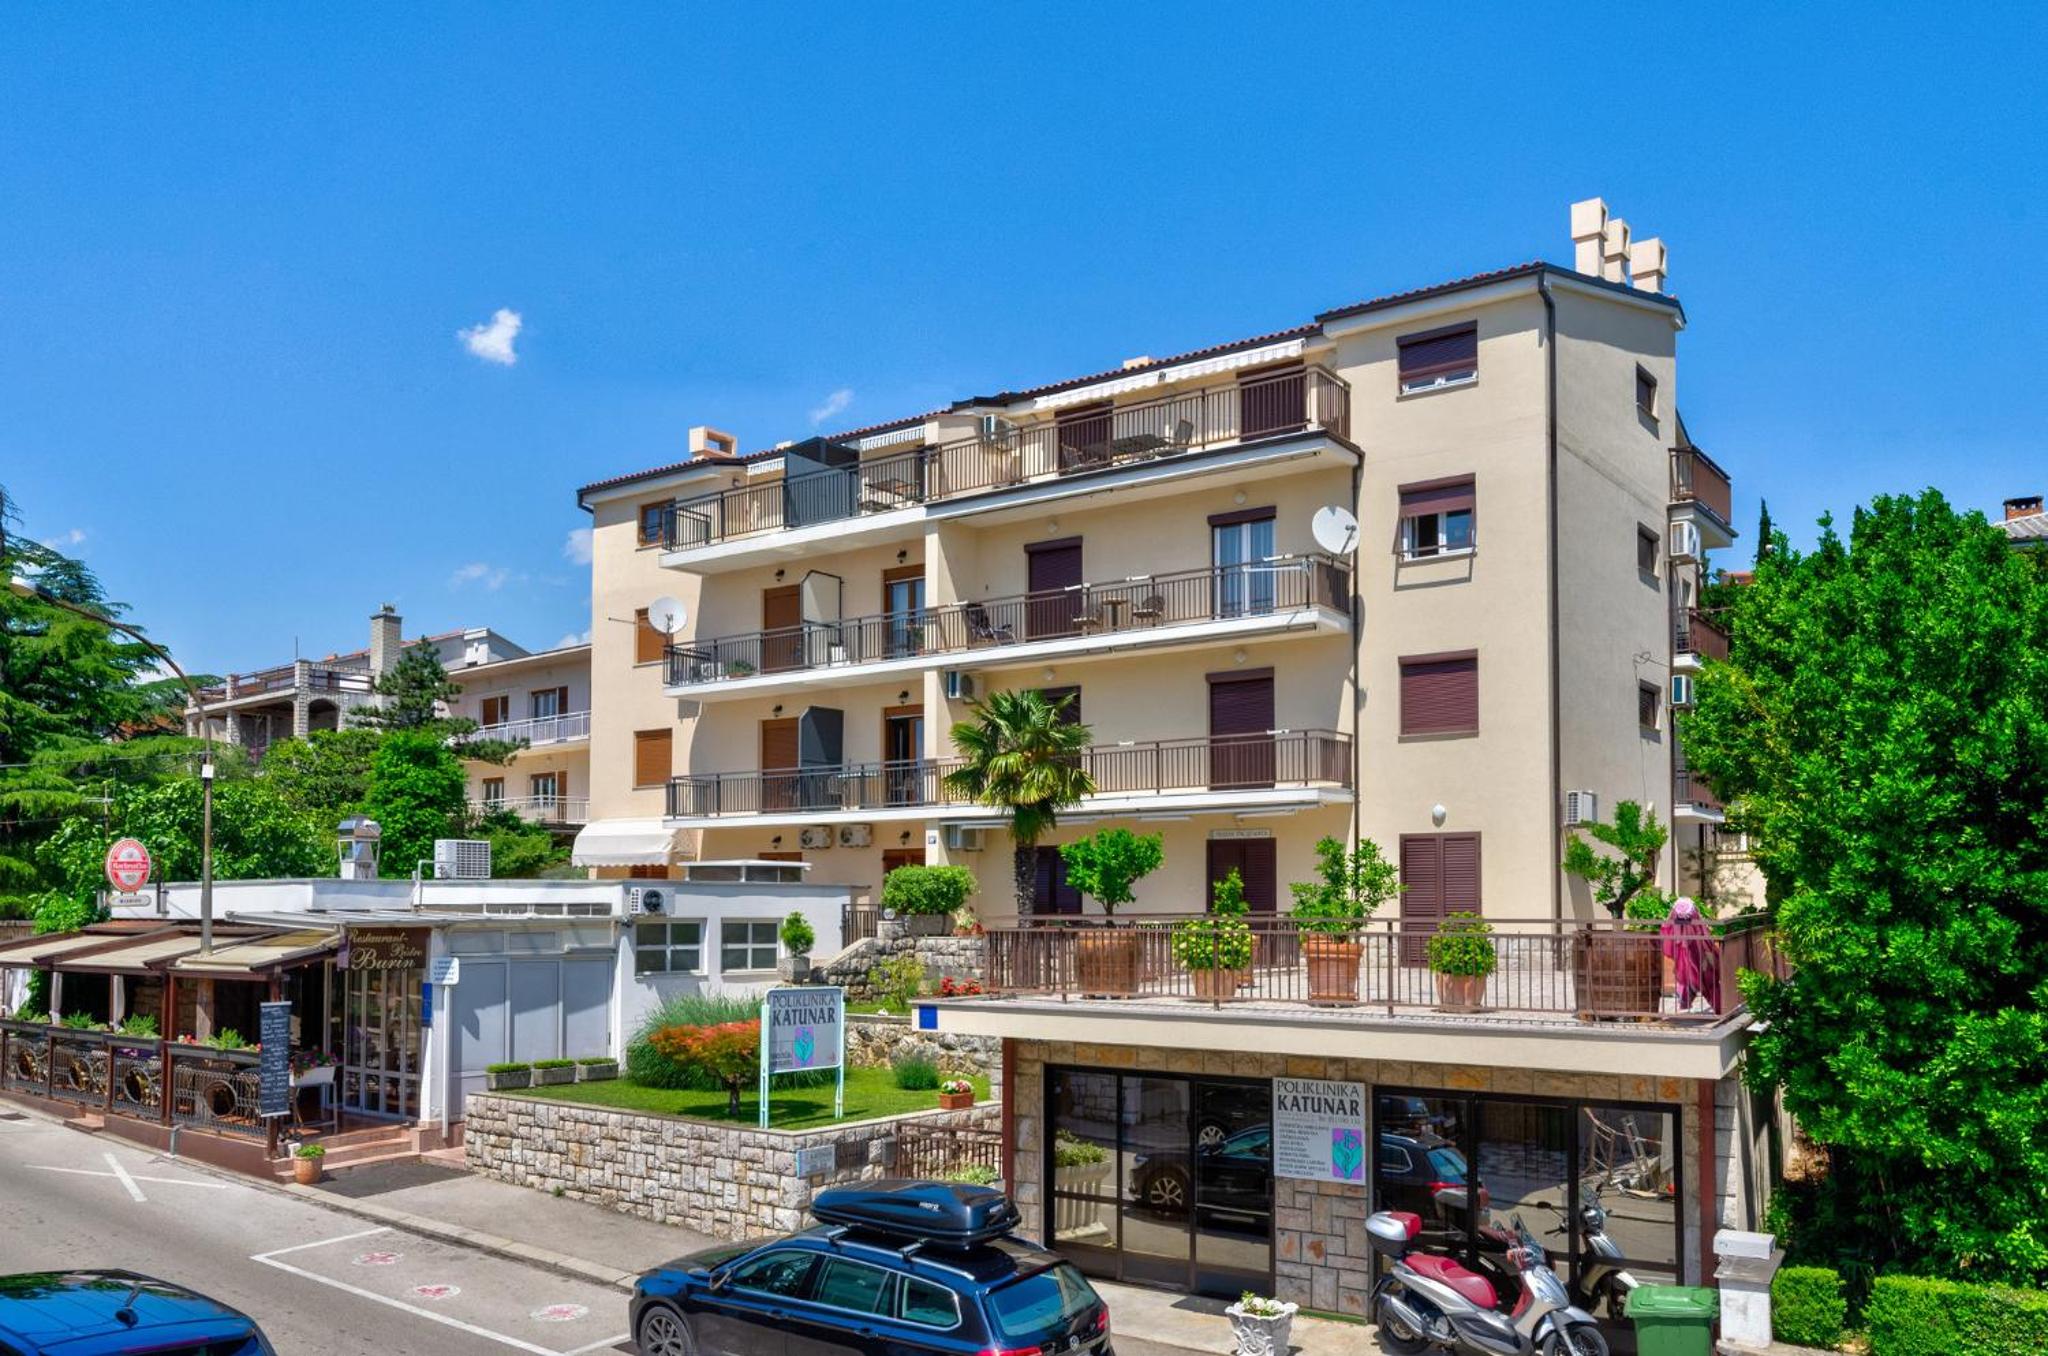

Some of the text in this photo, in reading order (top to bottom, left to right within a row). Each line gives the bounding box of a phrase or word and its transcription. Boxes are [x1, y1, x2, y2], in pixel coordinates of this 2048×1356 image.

[350, 948, 414, 969] Burin
[772, 993, 835, 1008] POLIKLINIKA
[772, 1008, 836, 1026] KATUNAR
[1277, 1080, 1360, 1098] POLIKLINIKA
[1277, 1095, 1361, 1116] KATUNAR
